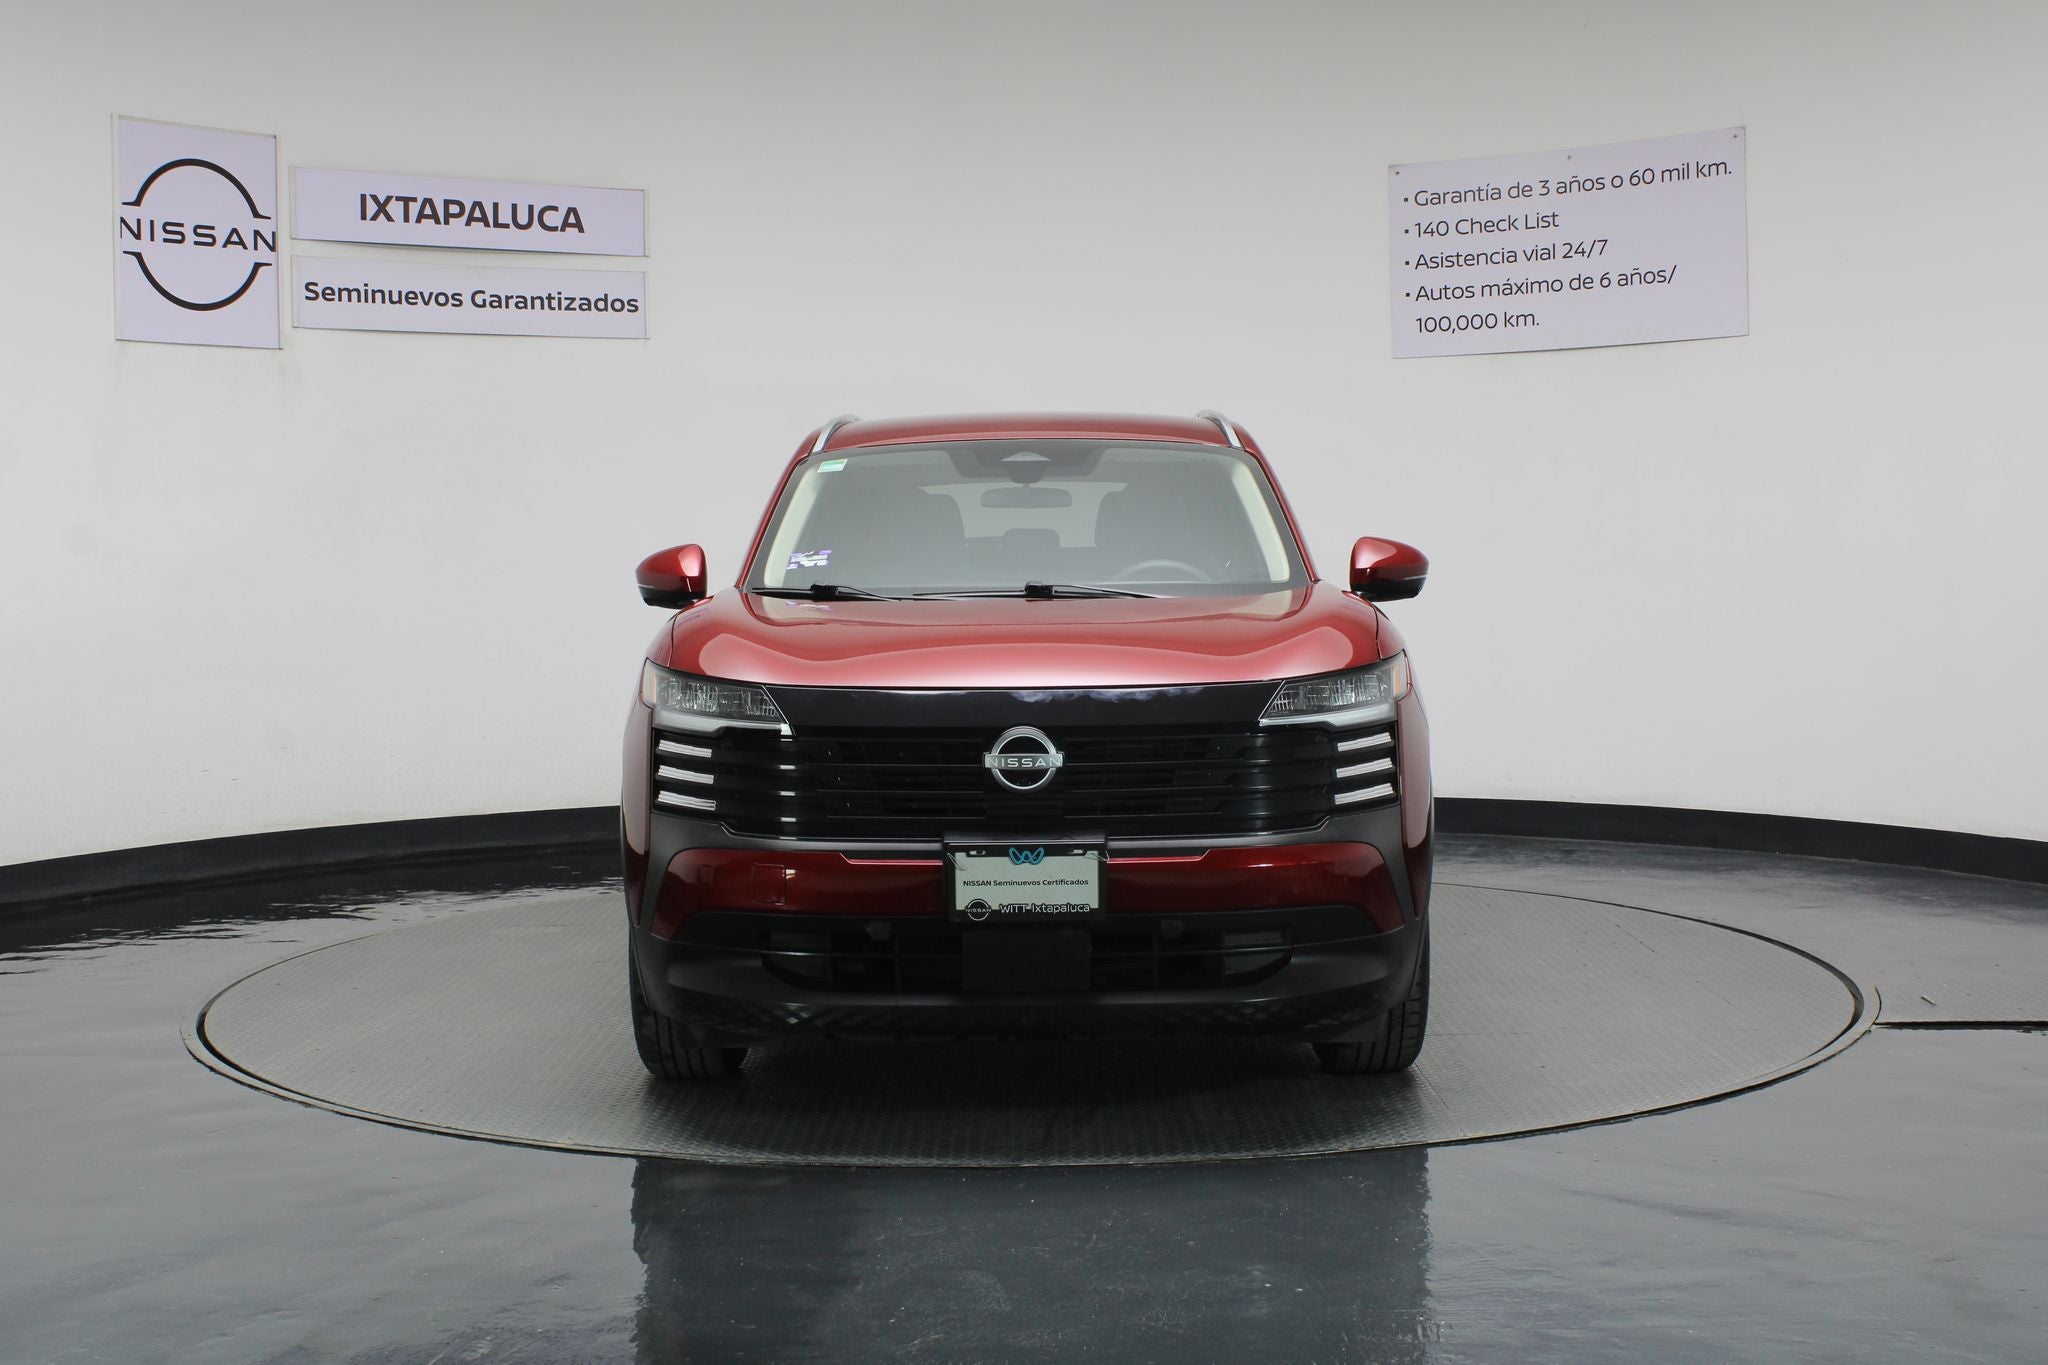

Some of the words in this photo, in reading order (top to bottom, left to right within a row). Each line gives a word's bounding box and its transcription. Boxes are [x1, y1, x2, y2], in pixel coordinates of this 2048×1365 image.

[1414, 183, 1502, 206] Garantía
[1507, 181, 1533, 199] de
[1538, 180, 1551, 196] 3
[1556, 175, 1606, 194] años
[1610, 174, 1624, 189] o
[1629, 168, 1655, 187] 60
[1661, 162, 1691, 182] mil
[1696, 160, 1733, 179] km.
[359, 193, 585, 234] IXTAPALUCA
[1414, 221, 1449, 238] 140
[1455, 215, 1519, 235] Check
[1524, 211, 1560, 230] List
[120, 216, 277, 252] NISSAN
[1415, 248, 1518, 270] Asistencia
[1523, 244, 1556, 262] vial
[1562, 239, 1609, 259] 24/7
[303, 281, 464, 308] Seminuevos
[470, 289, 639, 313] Garantizados
[1415, 285, 1475, 302] Autos
[1481, 278, 1563, 297] máximo
[1569, 274, 1594, 291] de
[1599, 271, 1612, 288] 6
[1617, 265, 1677, 287] años/
[1415, 313, 1498, 334] 100,000
[1503, 311, 1540, 328] km.
[986, 757, 1061, 768] NISSAN
[993, 879, 1041, 887] Seminuevos
[1042, 878, 1089, 886] Certificados
[999, 904, 1029, 914] WITT
[1031, 903, 1090, 914] Ixtapaluca
